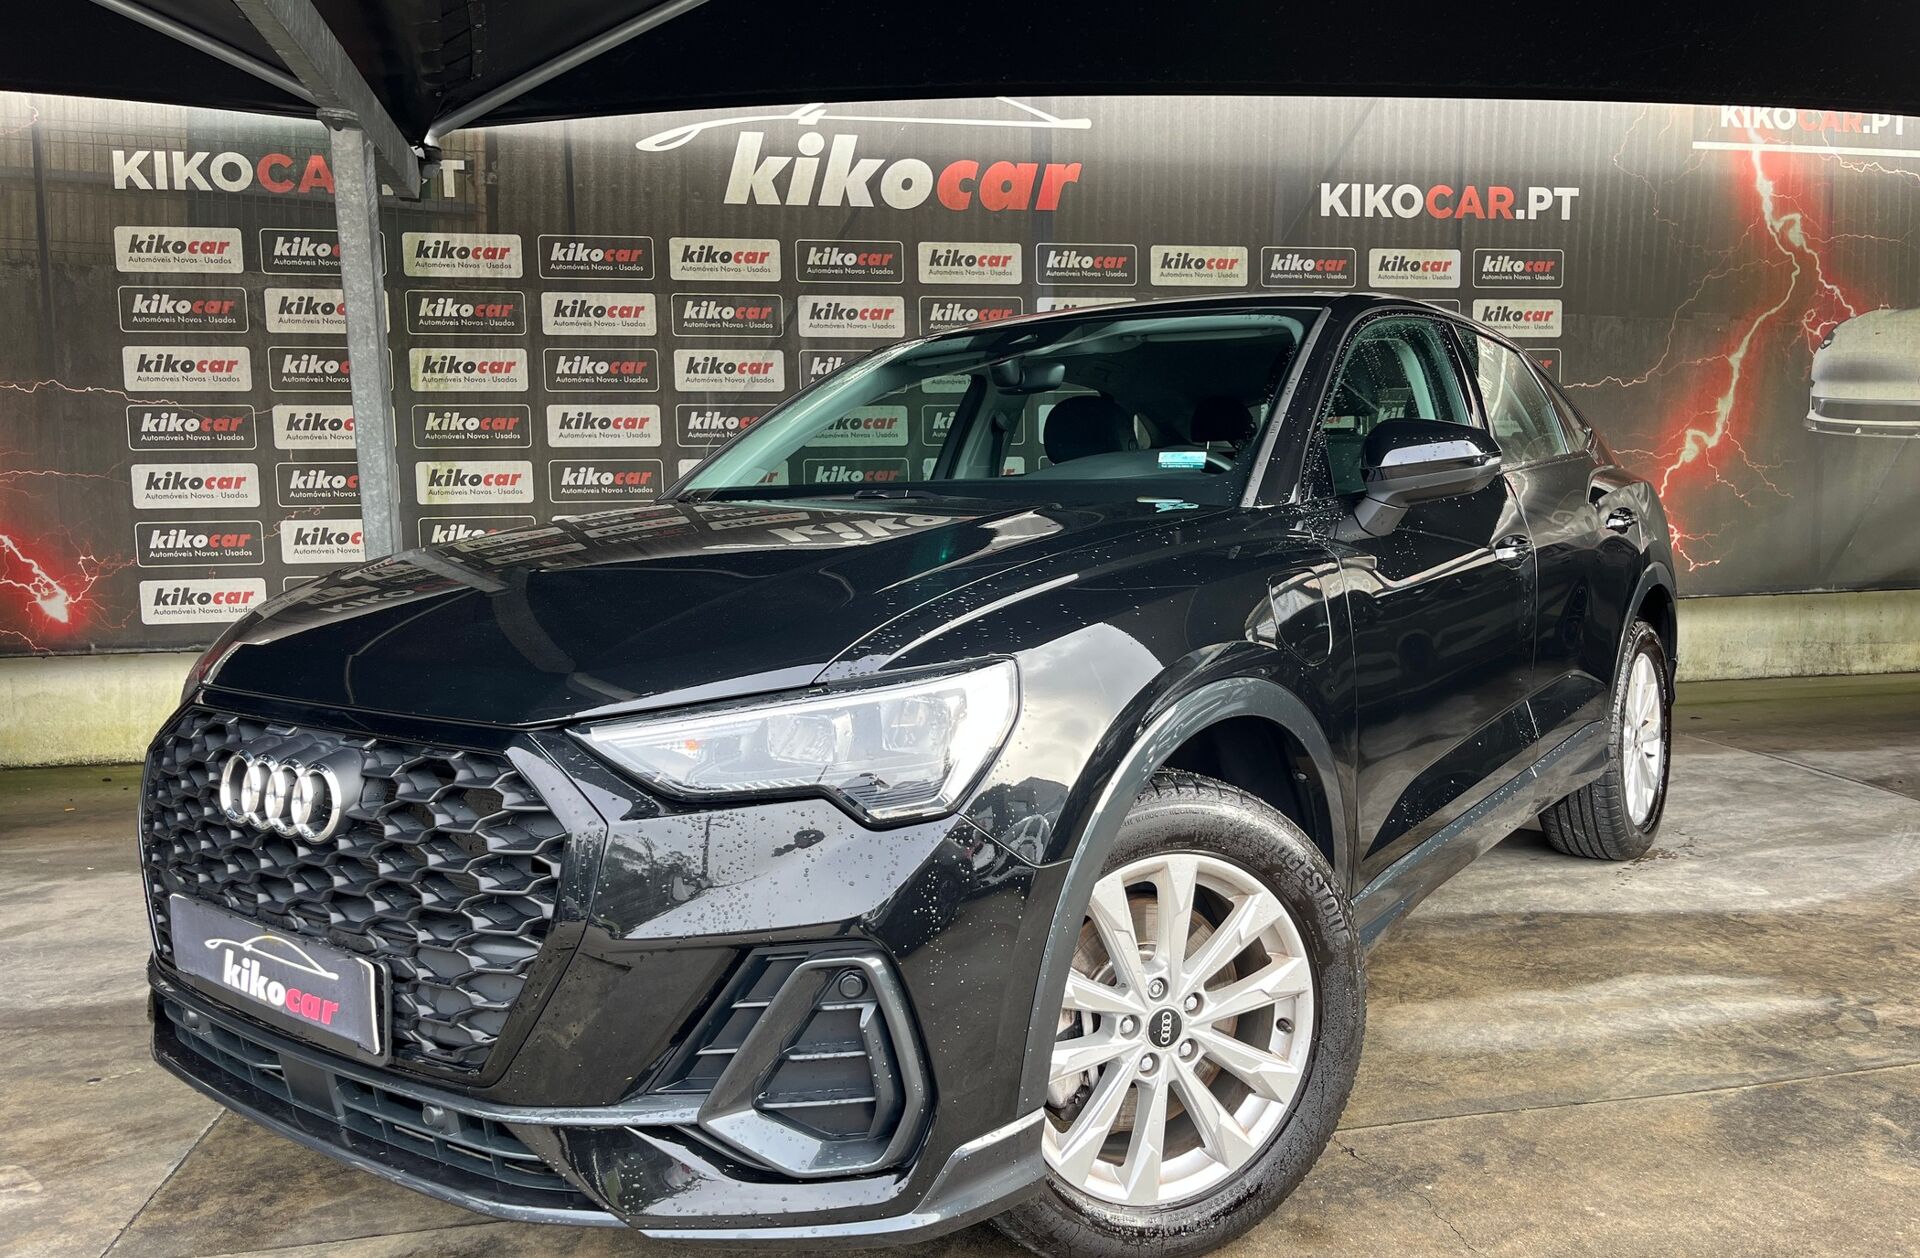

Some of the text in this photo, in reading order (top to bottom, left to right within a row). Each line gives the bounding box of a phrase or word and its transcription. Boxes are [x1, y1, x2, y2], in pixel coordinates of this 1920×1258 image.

[724, 132, 1082, 211] kikocar
[1320, 182, 1580, 221] KIKOCAR.PT
[128, 235, 230, 256] kikocar
[274, 237, 340, 256] kikoc
[415, 240, 510, 260] kikocar
[551, 243, 642, 263] kikocar
[682, 245, 770, 265] kikocar
[807, 248, 892, 266] kikocar
[929, 250, 1012, 267] kikocar
[1046, 251, 1126, 269] kikocar
[1161, 253, 1238, 270] kikocar
[1271, 254, 1346, 271] kikocar
[1378, 256, 1452, 272] kikocar
[1482, 256, 1554, 272] kikocar
[133, 294, 234, 314] kikocar
[278, 296, 345, 315] kikoc
[419, 298, 513, 317] kikocar
[554, 300, 644, 318] kikocar
[684, 301, 772, 320] kikocar
[810, 303, 894, 320] kikocar
[930, 303, 1012, 321] kikocar
[1482, 306, 1554, 321] kikocar
[137, 354, 238, 374] kikocar
[282, 355, 349, 374] kikoc
[422, 356, 516, 374] kikocar
[556, 356, 646, 374] kikocar
[686, 357, 773, 374] kikocar
[141, 413, 242, 432] kikocar
[286, 413, 353, 432] kikoc
[425, 413, 518, 431] kikocar
[559, 412, 649, 429] kikocar
[688, 411, 759, 429] kikoc
[146, 471, 246, 491] kikocar
[290, 470, 358, 489] kikoc
[428, 468, 521, 487] kikocar
[561, 467, 651, 486] kikocar
[815, 466, 897, 482] kikocar
[150, 529, 250, 550] kikocar
[294, 527, 361, 545] kikoc
[154, 586, 254, 607] kikocar
[223, 949, 339, 1025] kikocar
